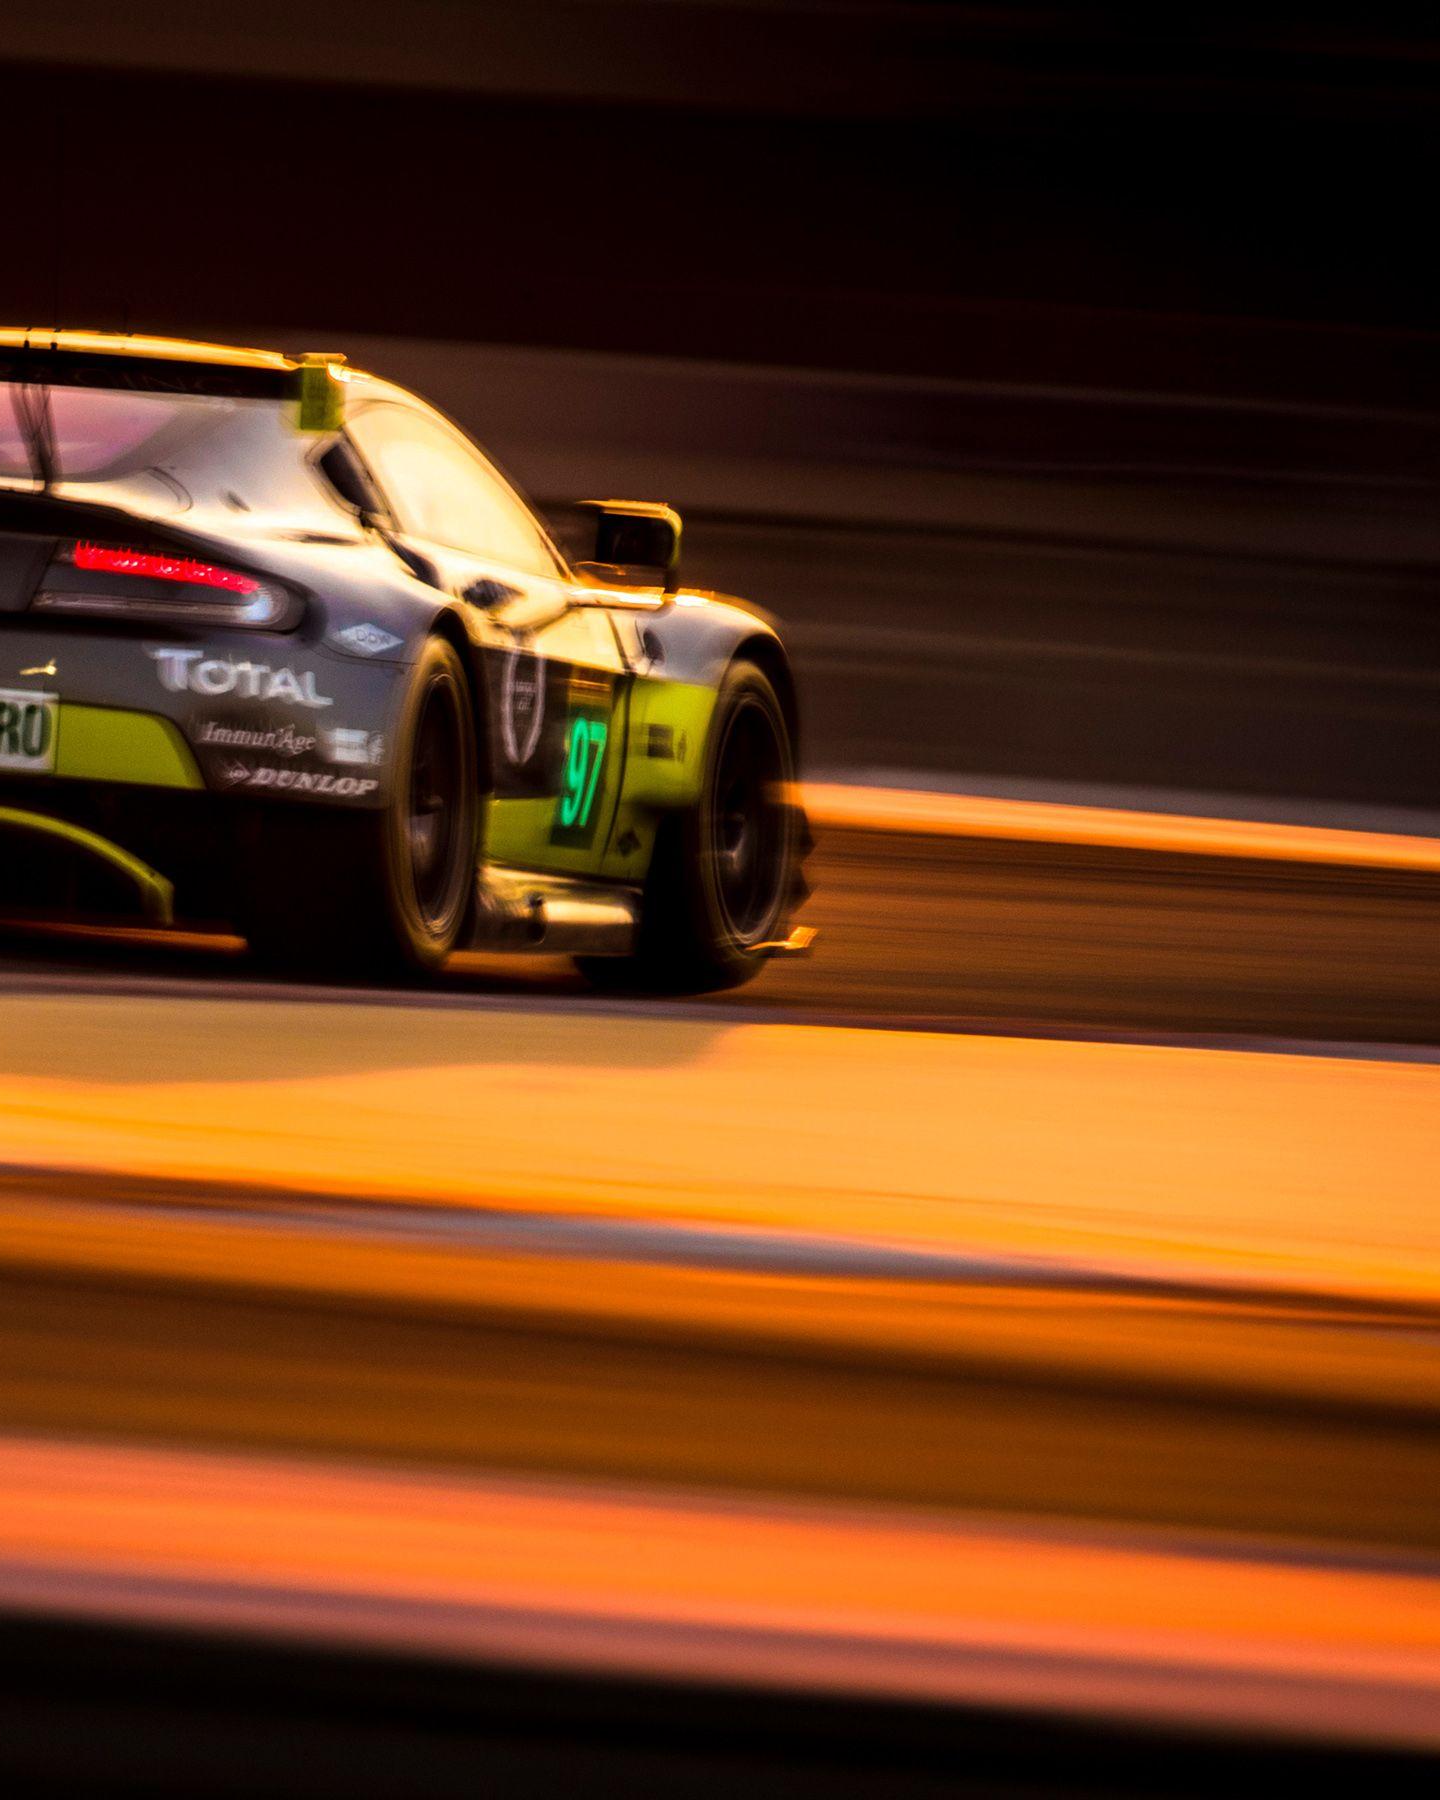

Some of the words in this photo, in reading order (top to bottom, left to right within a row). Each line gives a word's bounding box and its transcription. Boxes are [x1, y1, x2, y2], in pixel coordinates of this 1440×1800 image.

[147, 647, 334, 708] TOTAL
[250, 766, 380, 796] DUNLOP
[561, 717, 608, 828] 97
